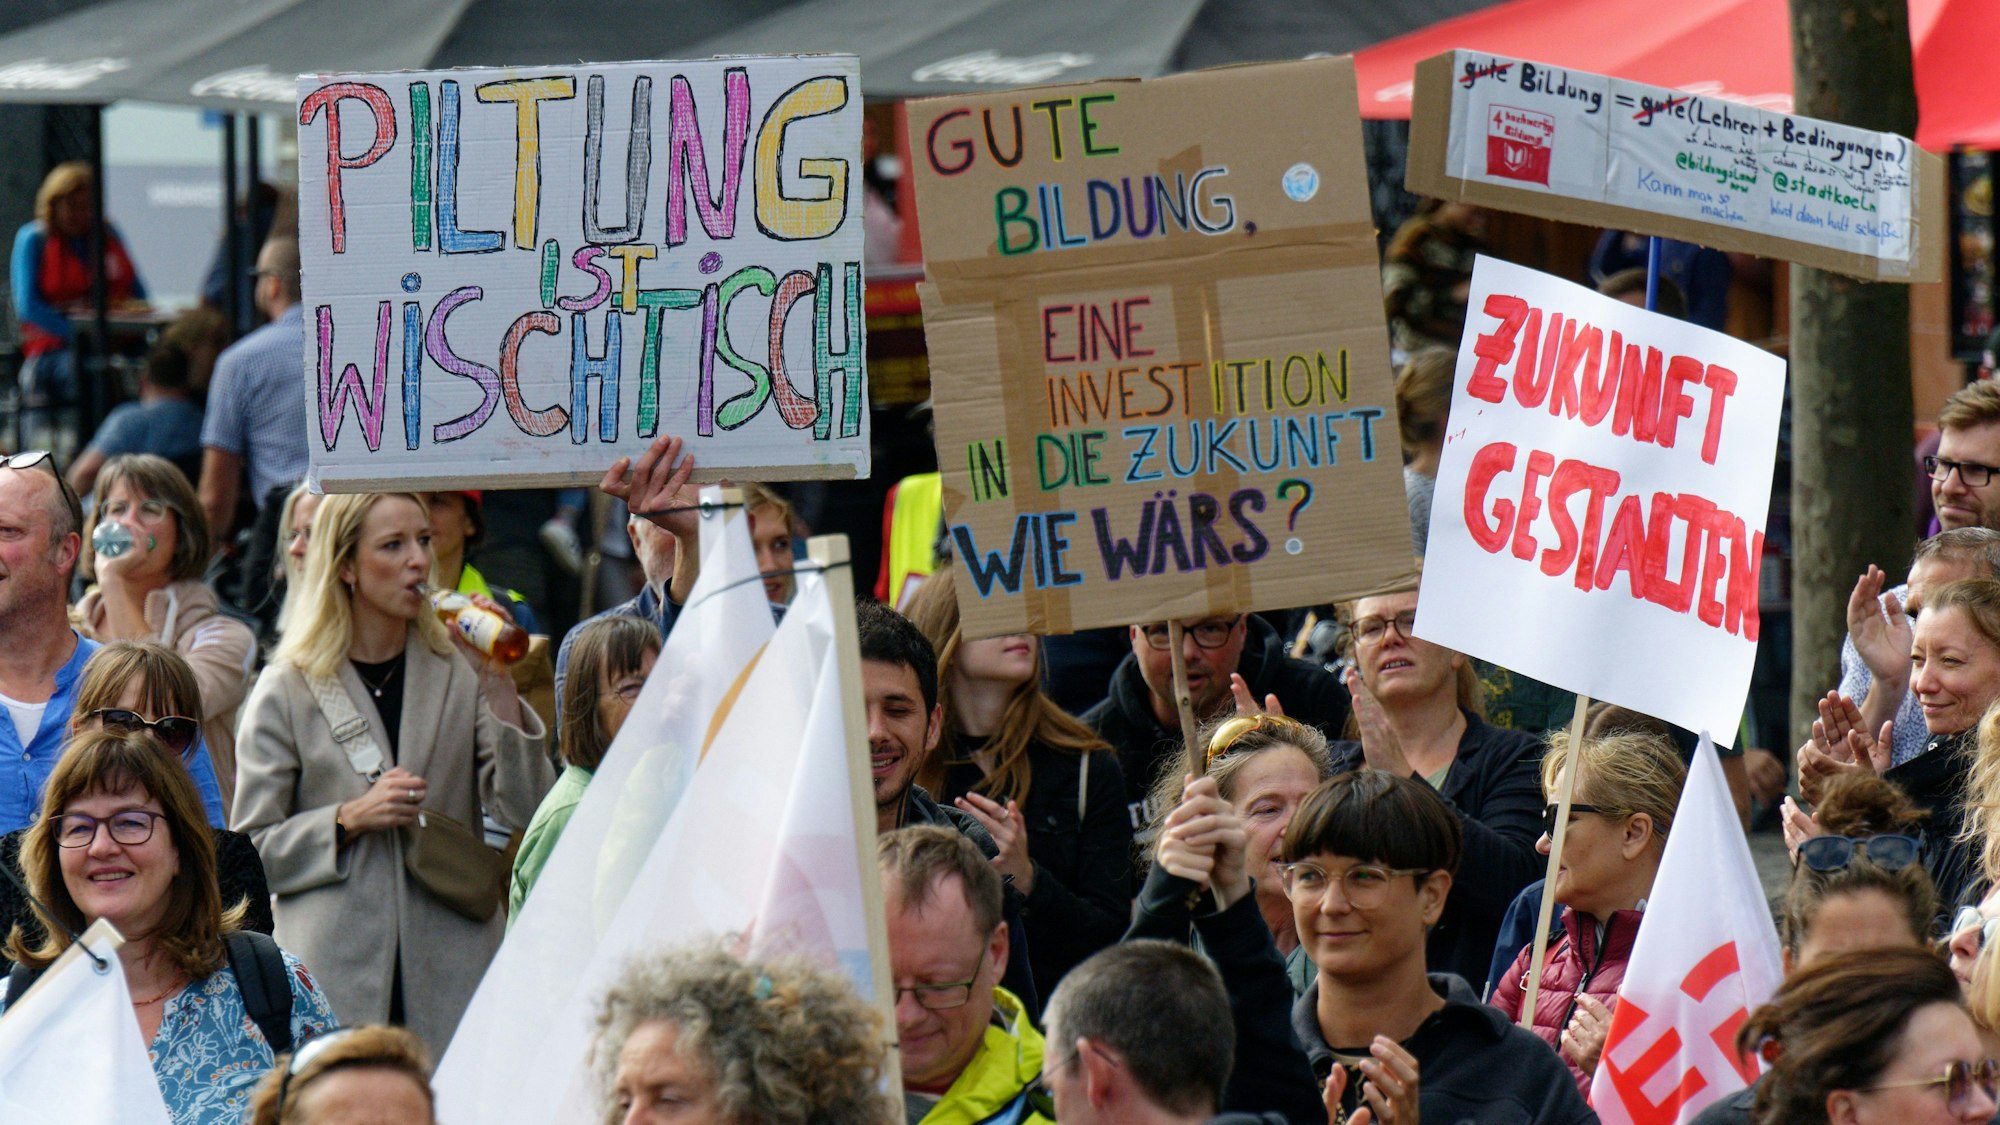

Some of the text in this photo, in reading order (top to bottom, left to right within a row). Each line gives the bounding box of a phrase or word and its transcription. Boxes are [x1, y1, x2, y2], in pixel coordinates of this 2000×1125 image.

[925, 93, 1121, 176] GUTE
[1462, 58, 1509, 89] gute
[1782, 118, 1906, 170] Bedingungen)
[1493, 110, 1503, 130] 4
[299, 66, 850, 257] PILTUNG
[1637, 167, 1683, 198] Kann
[1718, 193, 1731, 204] so
[1772, 171, 1877, 213] @stadtkoeln
[994, 166, 1259, 256] BILDUNG,
[539, 238, 657, 314] IST
[1042, 296, 1156, 364] EINE
[1467, 293, 1738, 466] ZUKUNFT
[966, 408, 1384, 502] IN DIE ZUKUNFT
[951, 511, 1084, 599] WIE
[1463, 442, 1766, 643] GESTALTEN
